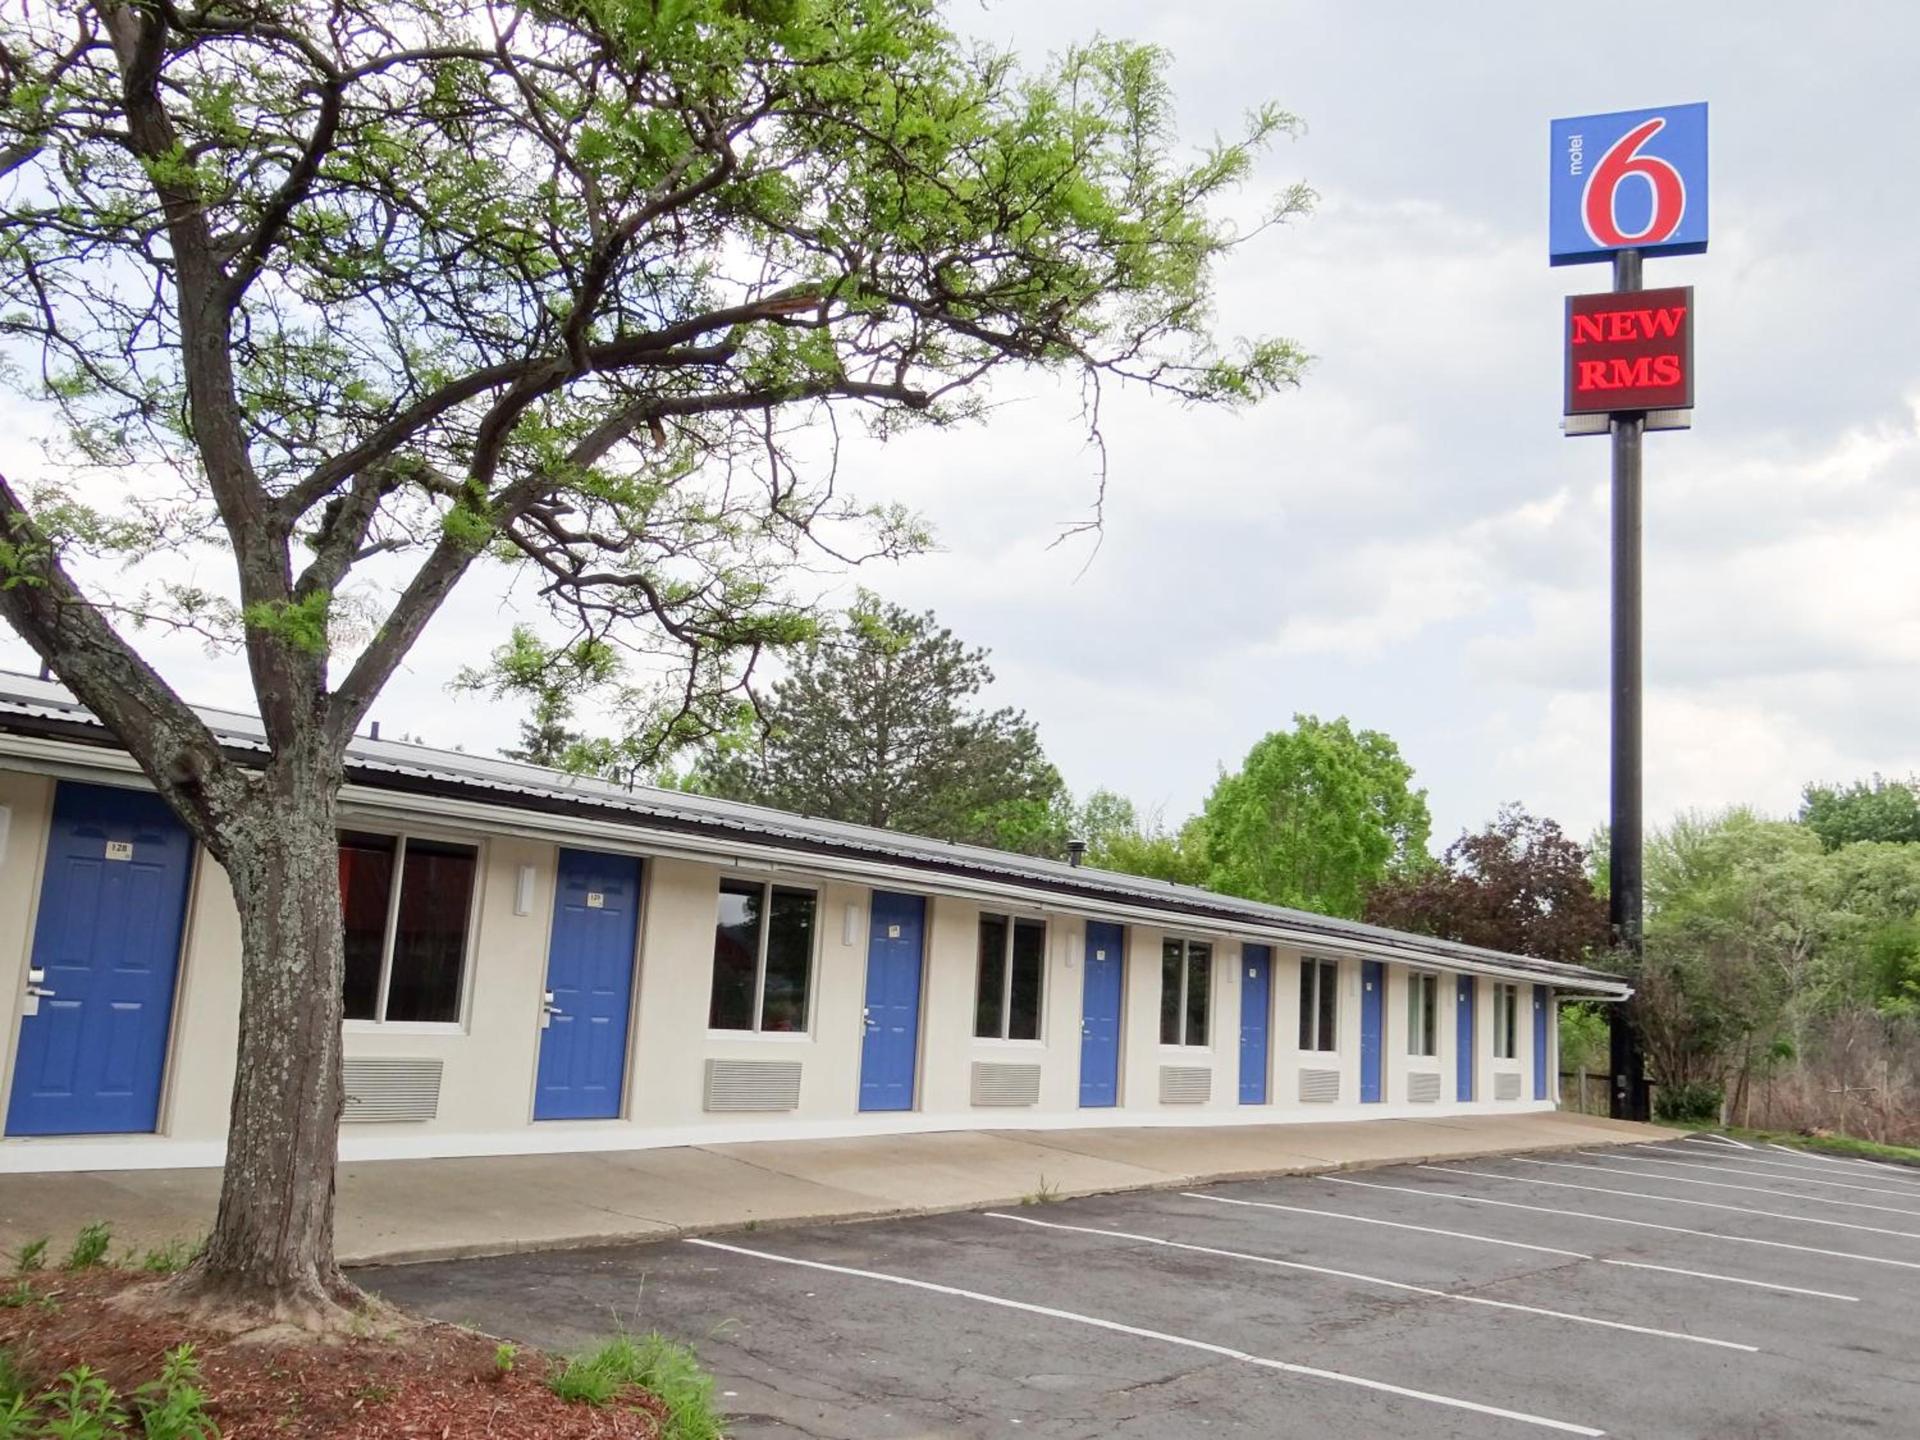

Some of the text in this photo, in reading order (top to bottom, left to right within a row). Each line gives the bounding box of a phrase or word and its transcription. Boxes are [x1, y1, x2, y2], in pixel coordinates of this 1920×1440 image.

[1568, 134, 1583, 175] motel
[1581, 117, 1686, 247] 6
[1572, 307, 1687, 344] NEW
[1578, 355, 1681, 391] RMS
